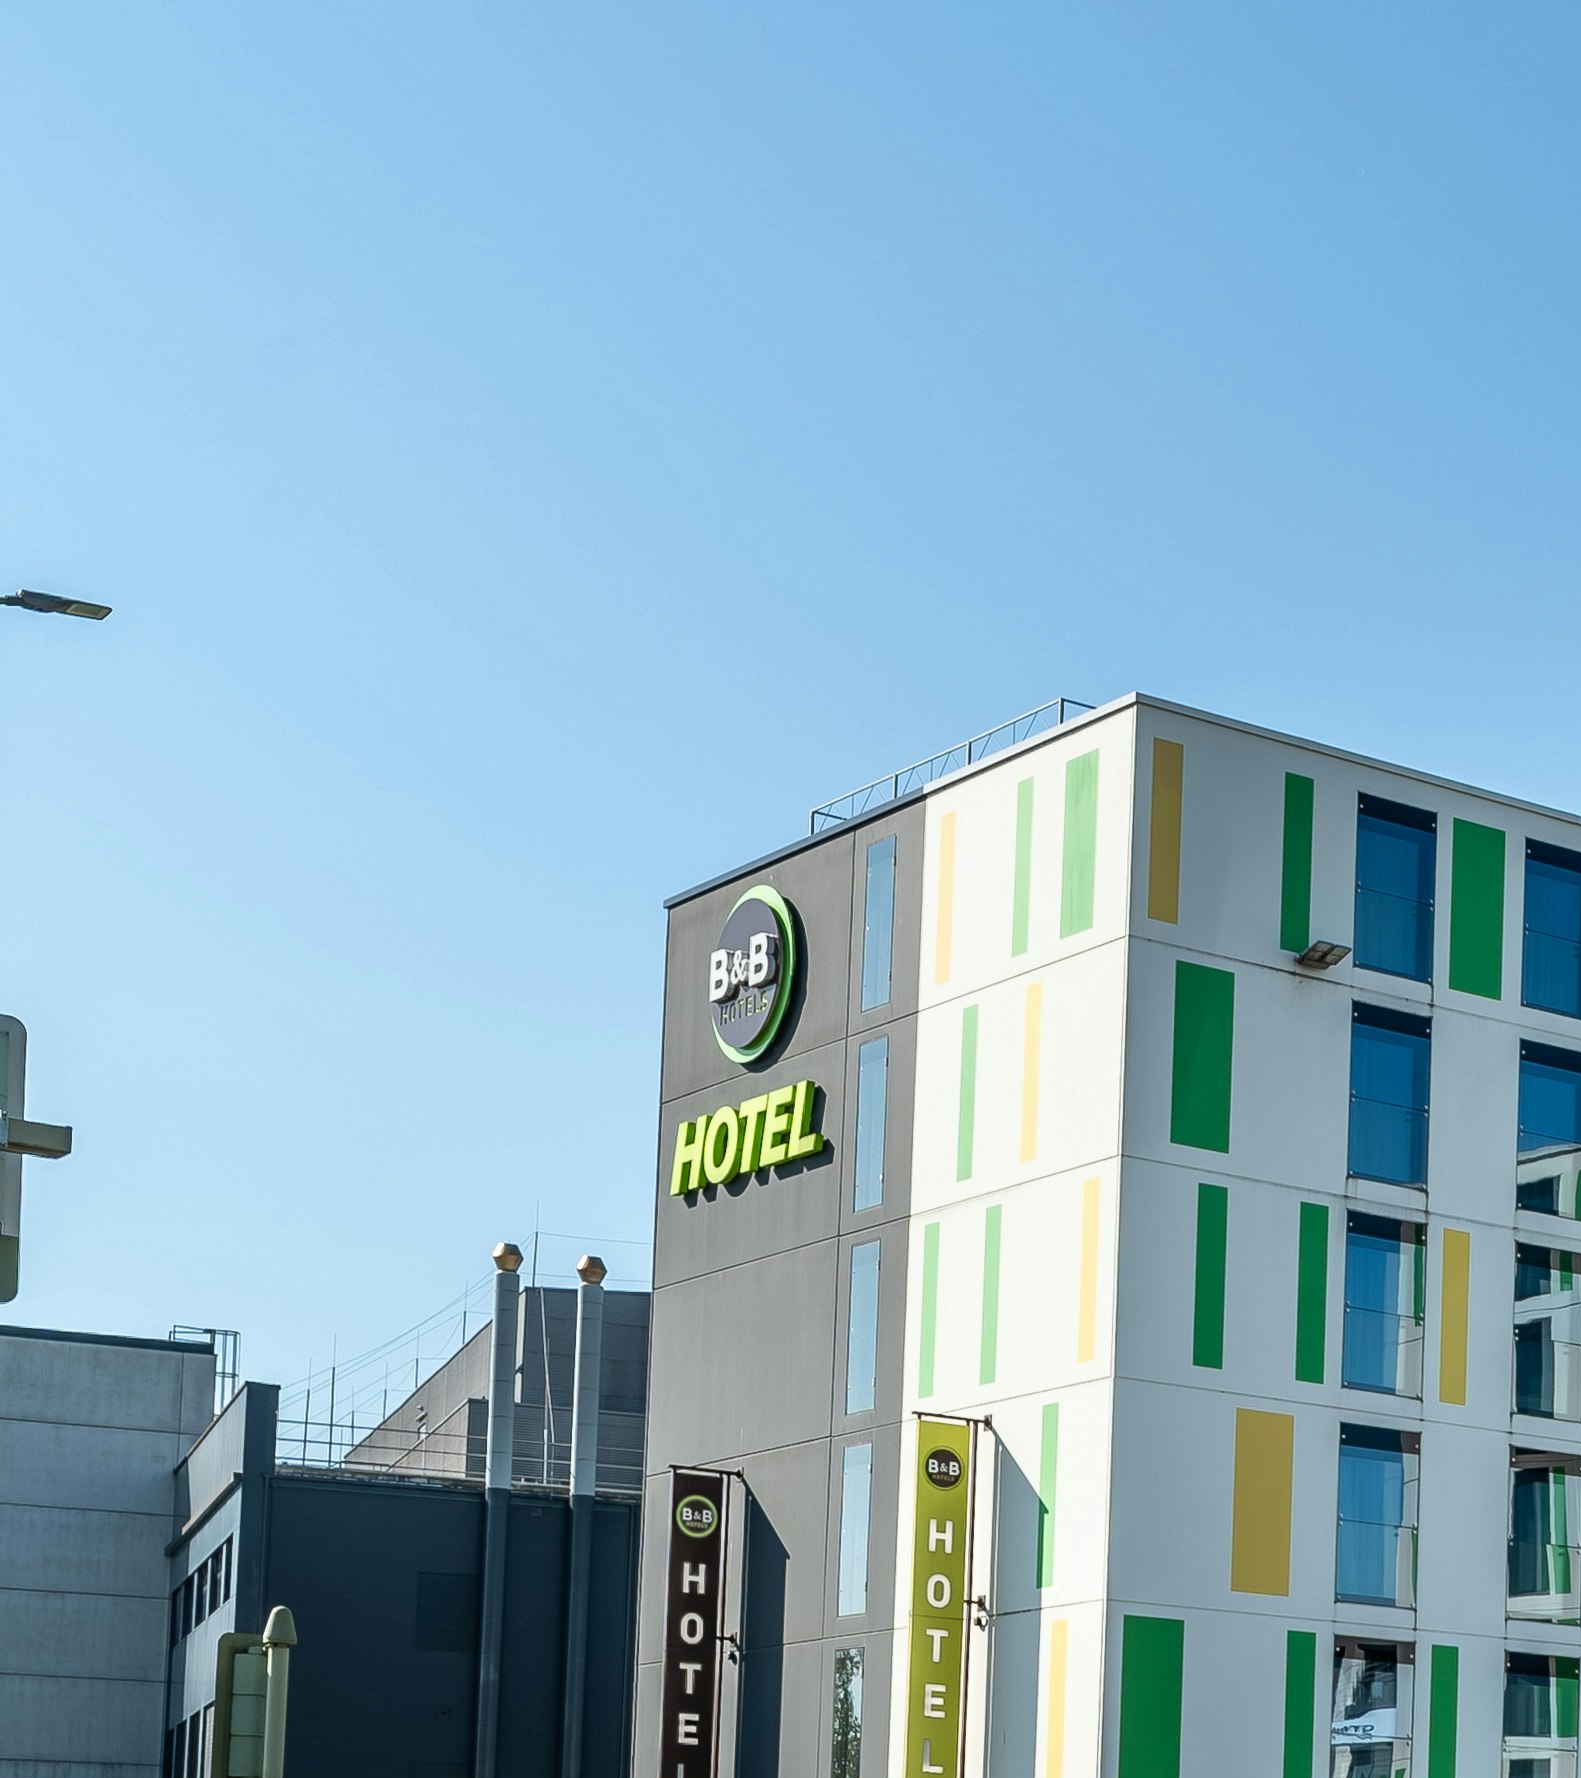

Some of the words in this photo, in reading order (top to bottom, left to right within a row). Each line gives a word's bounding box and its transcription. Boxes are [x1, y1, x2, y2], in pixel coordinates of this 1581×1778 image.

[709, 932, 774, 1003] B&B
[720, 990, 769, 1026] HOTELS
[669, 1079, 824, 1197] HOTEL
[928, 1458, 960, 1476] B&B
[682, 1507, 713, 1523] B&B
[921, 1518, 954, 1774] HOTEL
